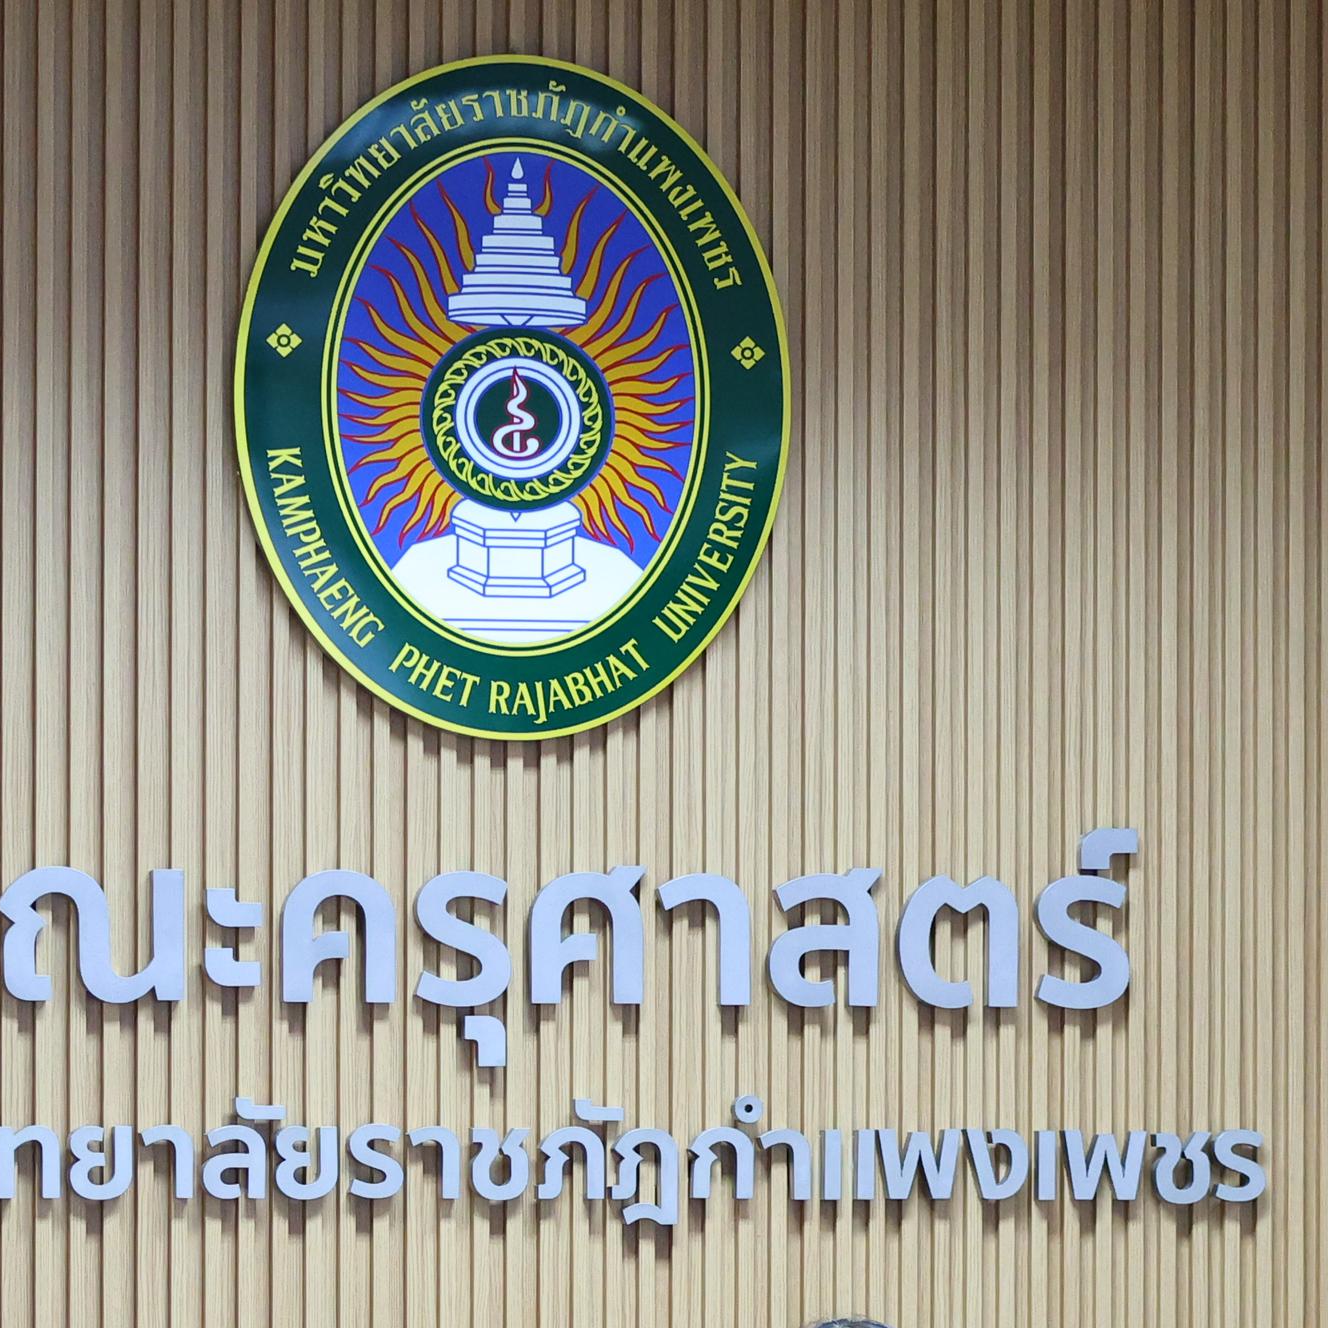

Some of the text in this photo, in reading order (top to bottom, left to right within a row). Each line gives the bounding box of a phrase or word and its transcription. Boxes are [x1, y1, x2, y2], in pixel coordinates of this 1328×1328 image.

[265, 447, 759, 724] KAMPHAENG PHET RAJABHAT UNIVERSITY
